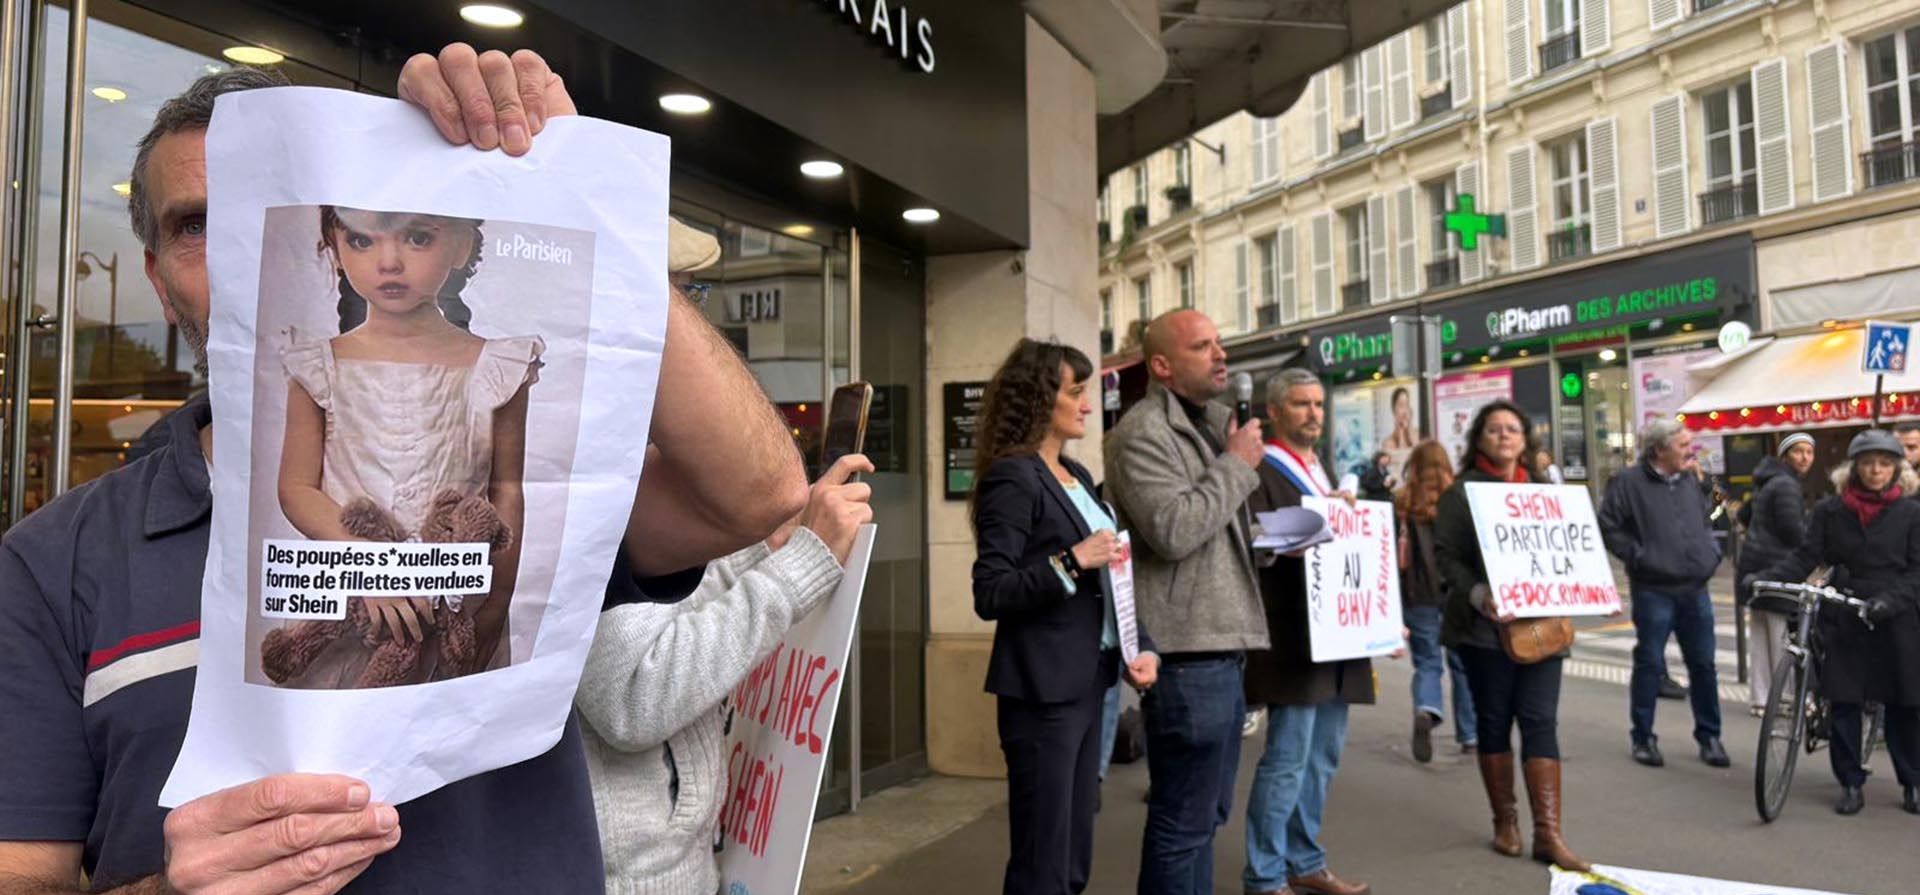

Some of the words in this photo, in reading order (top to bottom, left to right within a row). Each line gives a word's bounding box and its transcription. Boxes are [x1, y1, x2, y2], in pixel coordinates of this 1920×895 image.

[496, 238, 512, 257] Le
[513, 233, 572, 266] Parisien
[1500, 304, 1571, 336] iPharm
[1576, 296, 1612, 322] DES
[1616, 278, 1717, 314] ARCHIVES
[1327, 502, 1372, 538] HONTE
[1494, 523, 1594, 553] PARTICIPE
[267, 544, 294, 564] Des
[296, 547, 374, 569] poupées
[462, 552, 482, 566] en
[1343, 551, 1361, 588] AU
[1552, 555, 1574, 576] LA
[266, 568, 310, 589] forme
[313, 570, 336, 590] de
[339, 571, 411, 591] fillettes
[414, 571, 485, 590] vendues
[265, 596, 287, 612] sur
[288, 594, 338, 614] Shein
[1338, 588, 1372, 627] BHV
[772, 647, 839, 755] AVEC
